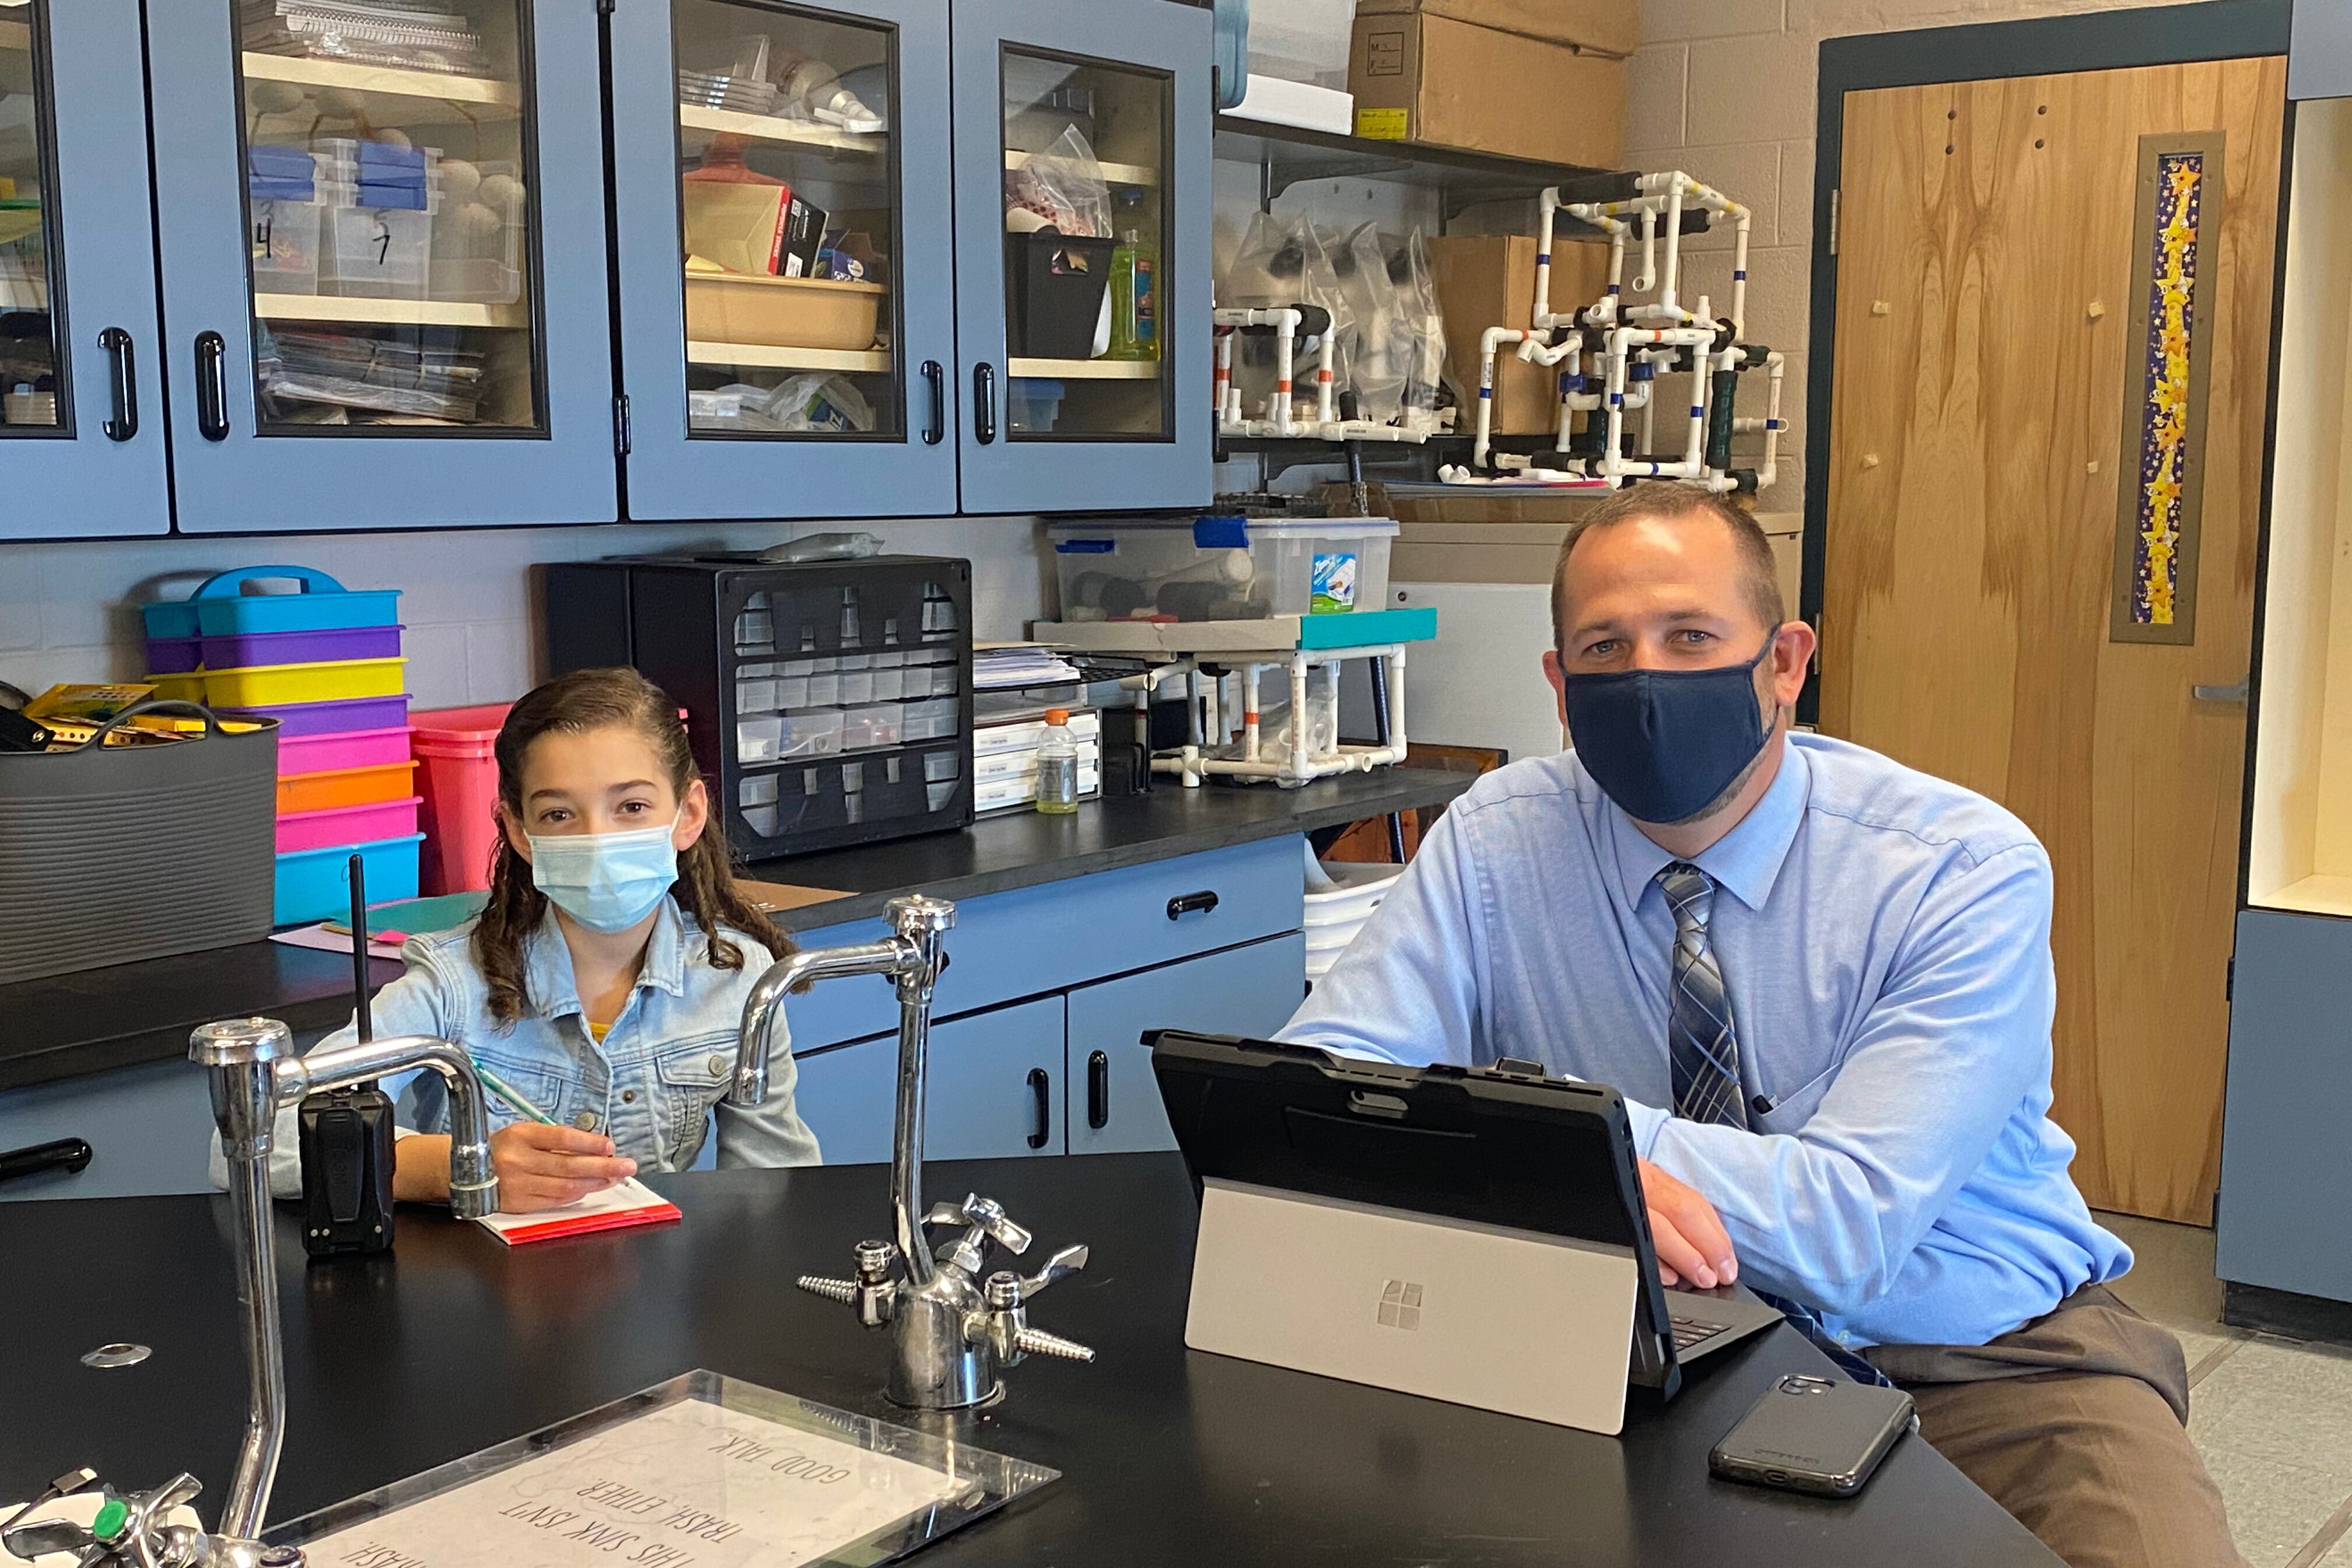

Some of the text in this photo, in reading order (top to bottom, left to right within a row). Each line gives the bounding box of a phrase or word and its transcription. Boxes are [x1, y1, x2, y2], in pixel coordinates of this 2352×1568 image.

[257, 218, 271, 258] 4
[372, 235, 390, 265] 7
[771, 1455, 850, 1484] GOOD
[576, 1478, 667, 1515] EITHER.
[498, 1501, 580, 1530] ISN'T
[562, 1521, 640, 1552] SINK
